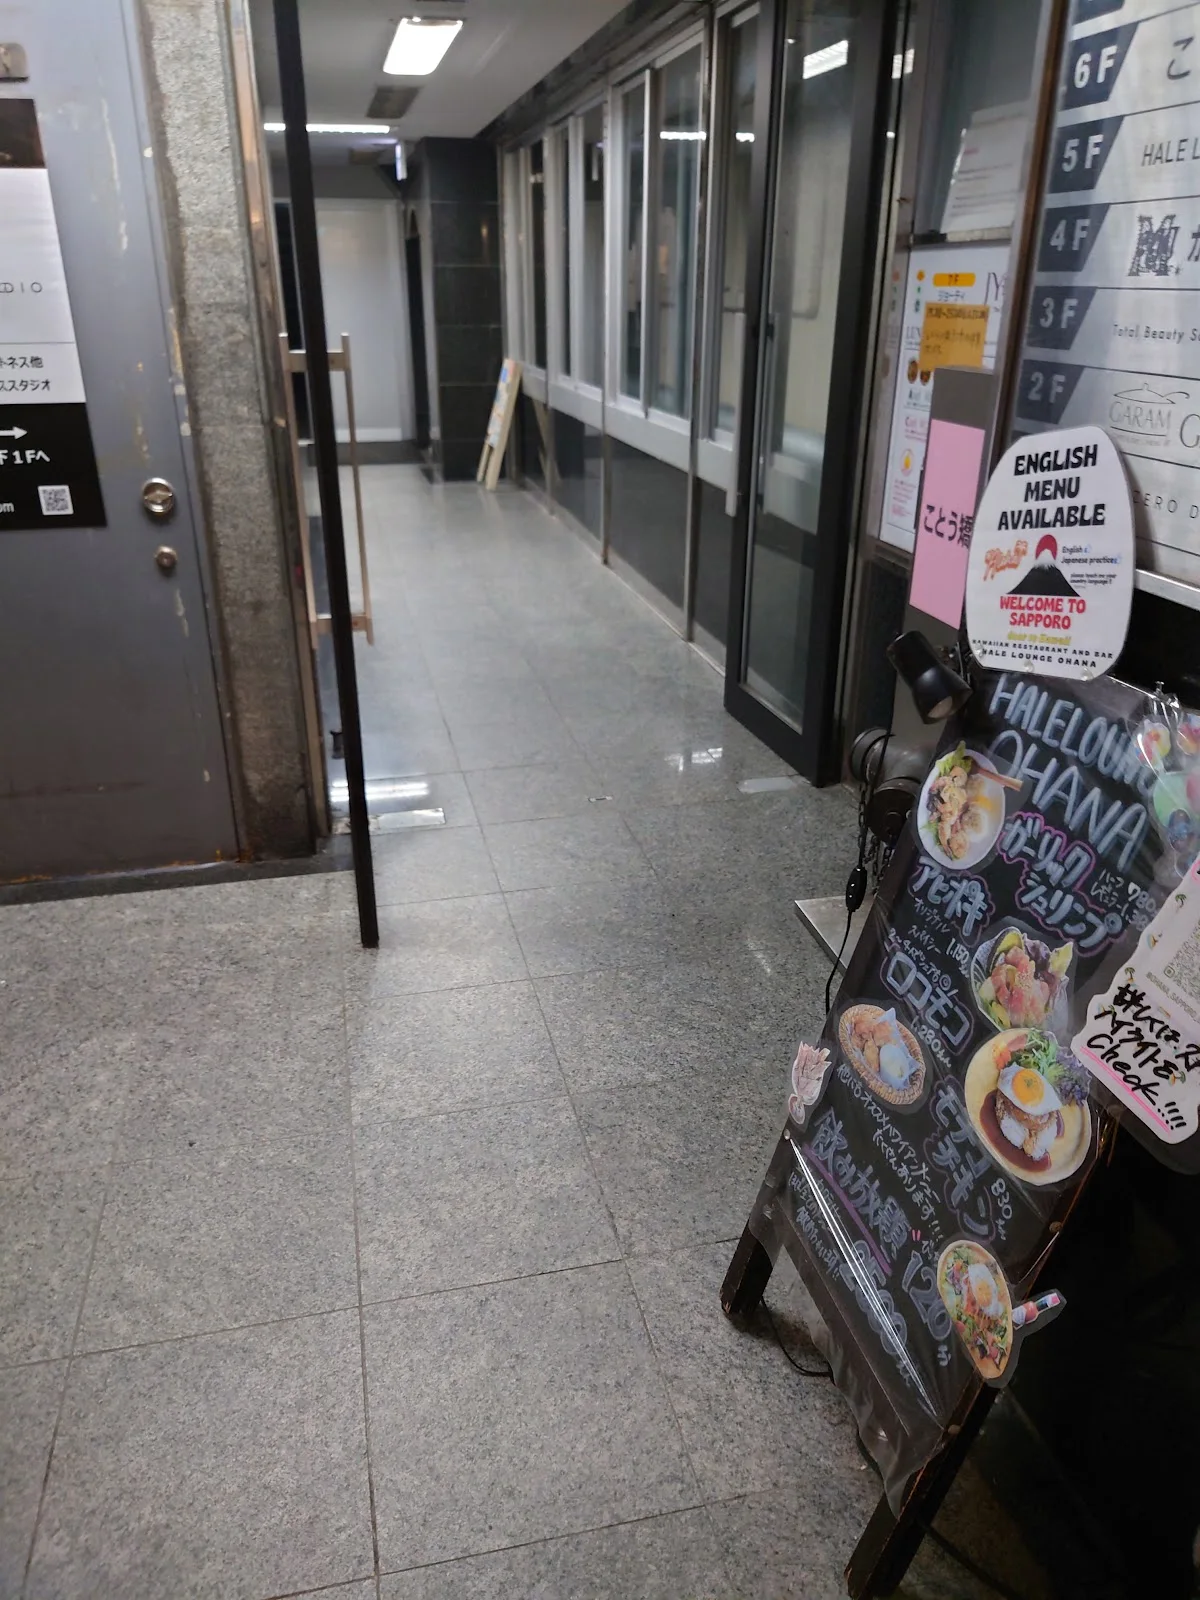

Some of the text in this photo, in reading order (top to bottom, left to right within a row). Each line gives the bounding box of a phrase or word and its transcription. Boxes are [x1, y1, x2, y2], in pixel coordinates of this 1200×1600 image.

[1074, 45, 1117, 88] 6F
[1061, 135, 1103, 172] 5F
[1141, 138, 1188, 167] HALE
[1050, 218, 1090, 251] 4F
[1039, 298, 1078, 328] 3F
[1113, 324, 1140, 338] Total
[1143, 325, 1185, 344] Beauty
[1028, 372, 1066, 403] 2F
[1109, 400, 1172, 430] GARAM
[1180, 414, 1200, 448] G
[1014, 444, 1098, 476] ENGLISH
[1024, 476, 1080, 503] MENU
[998, 503, 1105, 531] AVAILABLE
[1061, 556, 1088, 566] Japanese
[1062, 545, 1083, 555] English
[1000, 596, 1087, 614] WELCOME TO
[1010, 612, 1071, 630] SAPPORO
[972, 639, 1113, 660] HAWAIIAN RESTAURANT AND BAR
[1011, 651, 1053, 663] LOUNGE
[1058, 657, 1097, 668] OHANA
[886, 951, 970, 1046] ロコモコ
